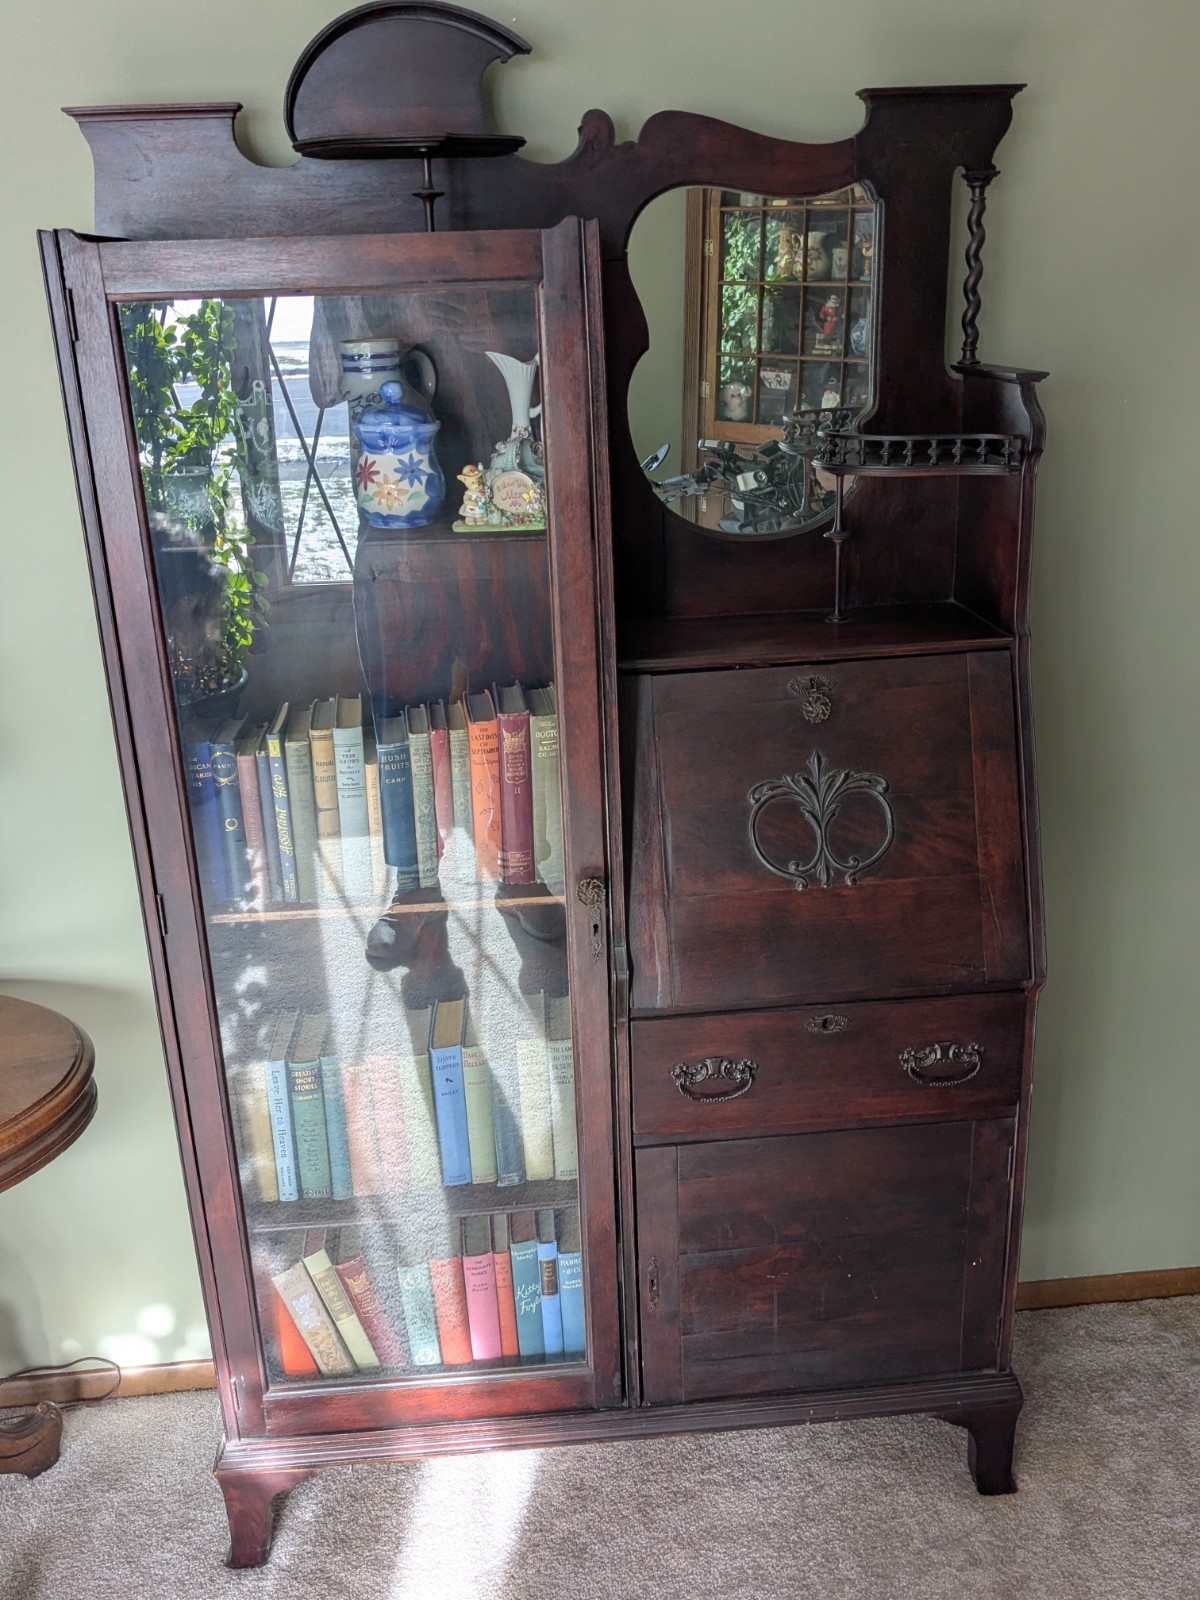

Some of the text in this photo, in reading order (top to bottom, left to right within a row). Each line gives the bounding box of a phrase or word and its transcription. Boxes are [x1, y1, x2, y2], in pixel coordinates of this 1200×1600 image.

[470, 747, 498, 755] SEPTEMBER
[272, 774, 287, 798] Hero
[371, 794, 379, 816] STORY
[275, 805, 293, 856] Assistant
[436, 1055, 457, 1063] SILVER
[435, 1063, 460, 1071] SLIPPERS
[552, 1062, 572, 1070] DESER
[291, 1069, 318, 1078] GREATEST
[295, 1076, 315, 1084] SHORT
[294, 1083, 318, 1091] STORIES
[271, 1070, 287, 1159] Leave Her to Heaven
[516, 1283, 540, 1300] Kitty
